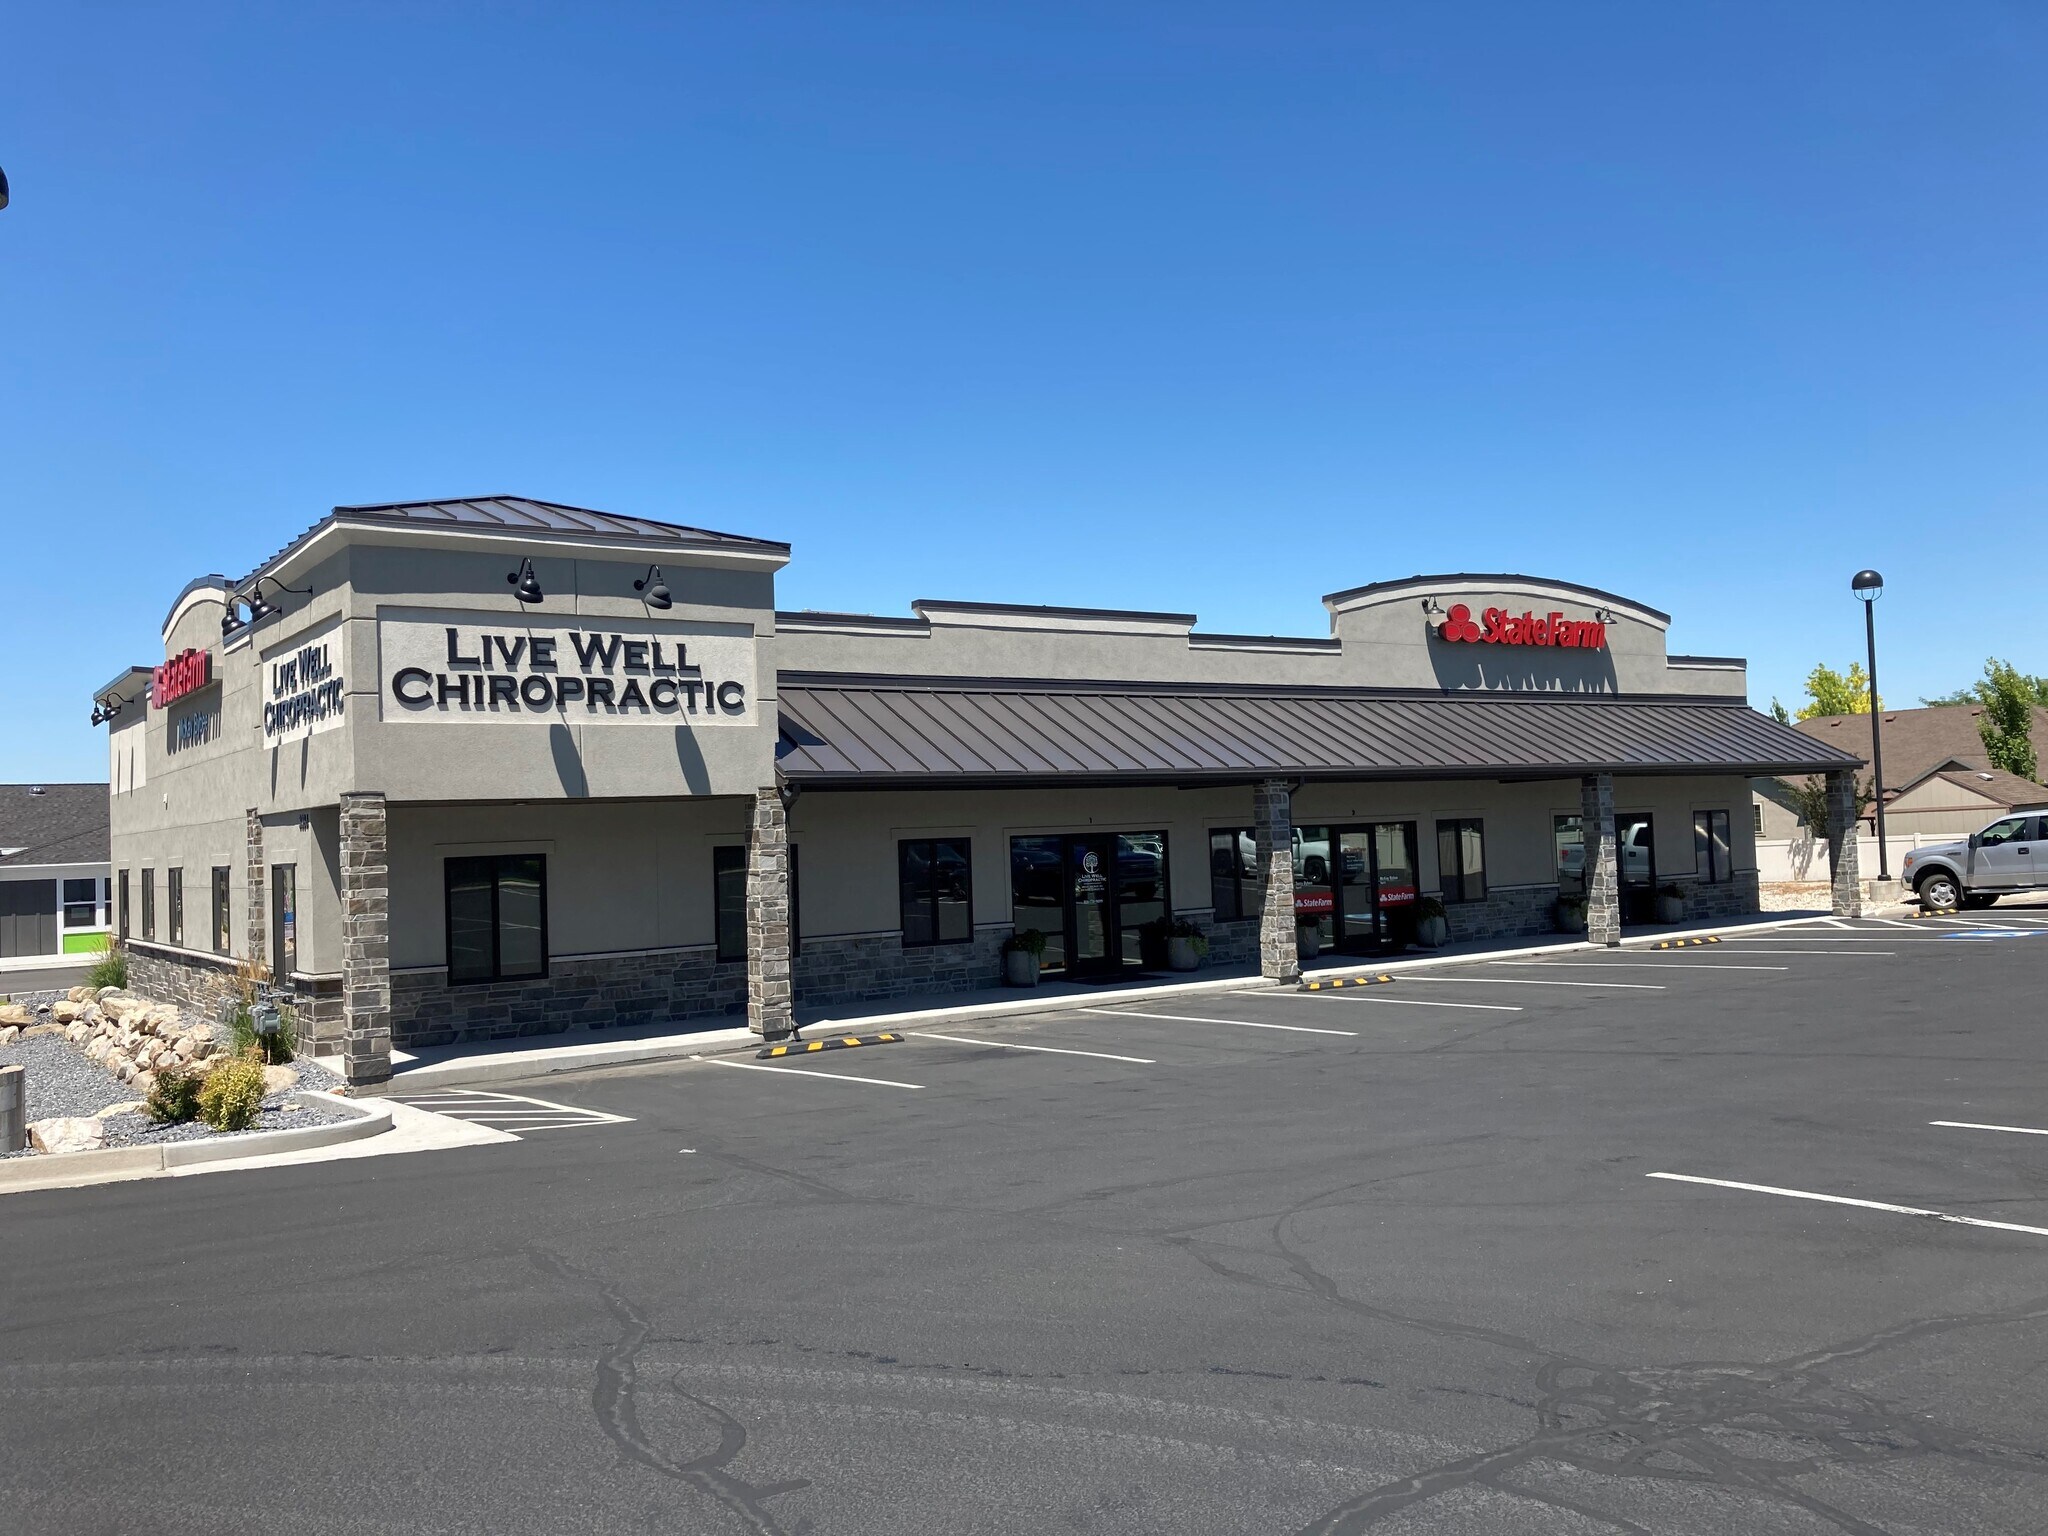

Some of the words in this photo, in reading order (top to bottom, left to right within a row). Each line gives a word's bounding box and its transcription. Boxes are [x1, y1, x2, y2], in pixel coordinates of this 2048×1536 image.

[273, 657, 298, 695] LIVE
[298, 644, 332, 681] WELL
[446, 628, 557, 668] LIVE
[569, 632, 701, 673] WELL
[264, 677, 344, 736] CHIROPRACTIC
[392, 667, 745, 711] CHIROPRACTIC
